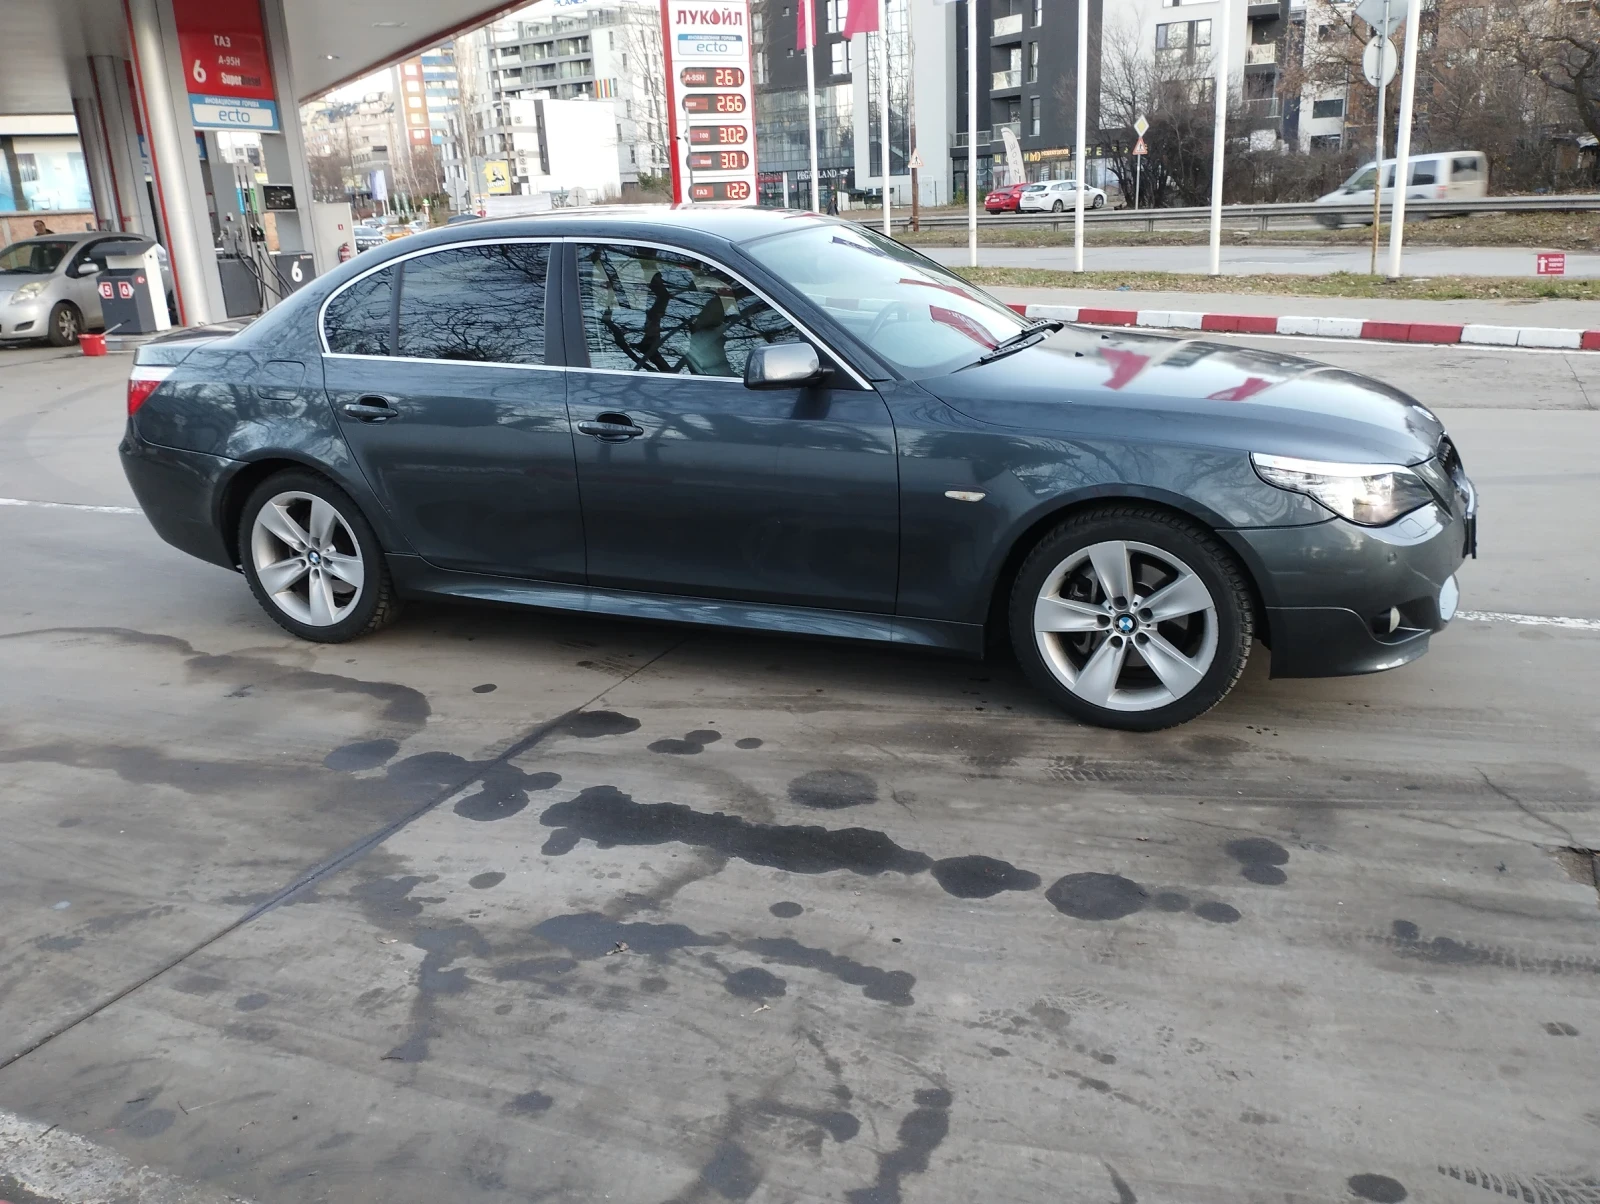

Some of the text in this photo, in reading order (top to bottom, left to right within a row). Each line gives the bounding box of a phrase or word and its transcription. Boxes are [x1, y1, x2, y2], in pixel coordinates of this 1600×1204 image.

[676, 7, 743, 26] ЛУКОЙЛ
[213, 34, 231, 48] ГАЗ
[696, 41, 728, 53] ecto
[192, 59, 207, 84] 6
[715, 69, 742, 86] 2.61
[717, 95, 743, 112] 2.66
[218, 108, 251, 123] ecto
[719, 127, 744, 143] 3.02
[720, 152, 746, 169] 3.01
[696, 182, 747, 199] ГАЗ 1.22
[291, 261, 303, 282] 6
[104, 285, 112, 296] 5
[121, 284, 129, 296] 6
